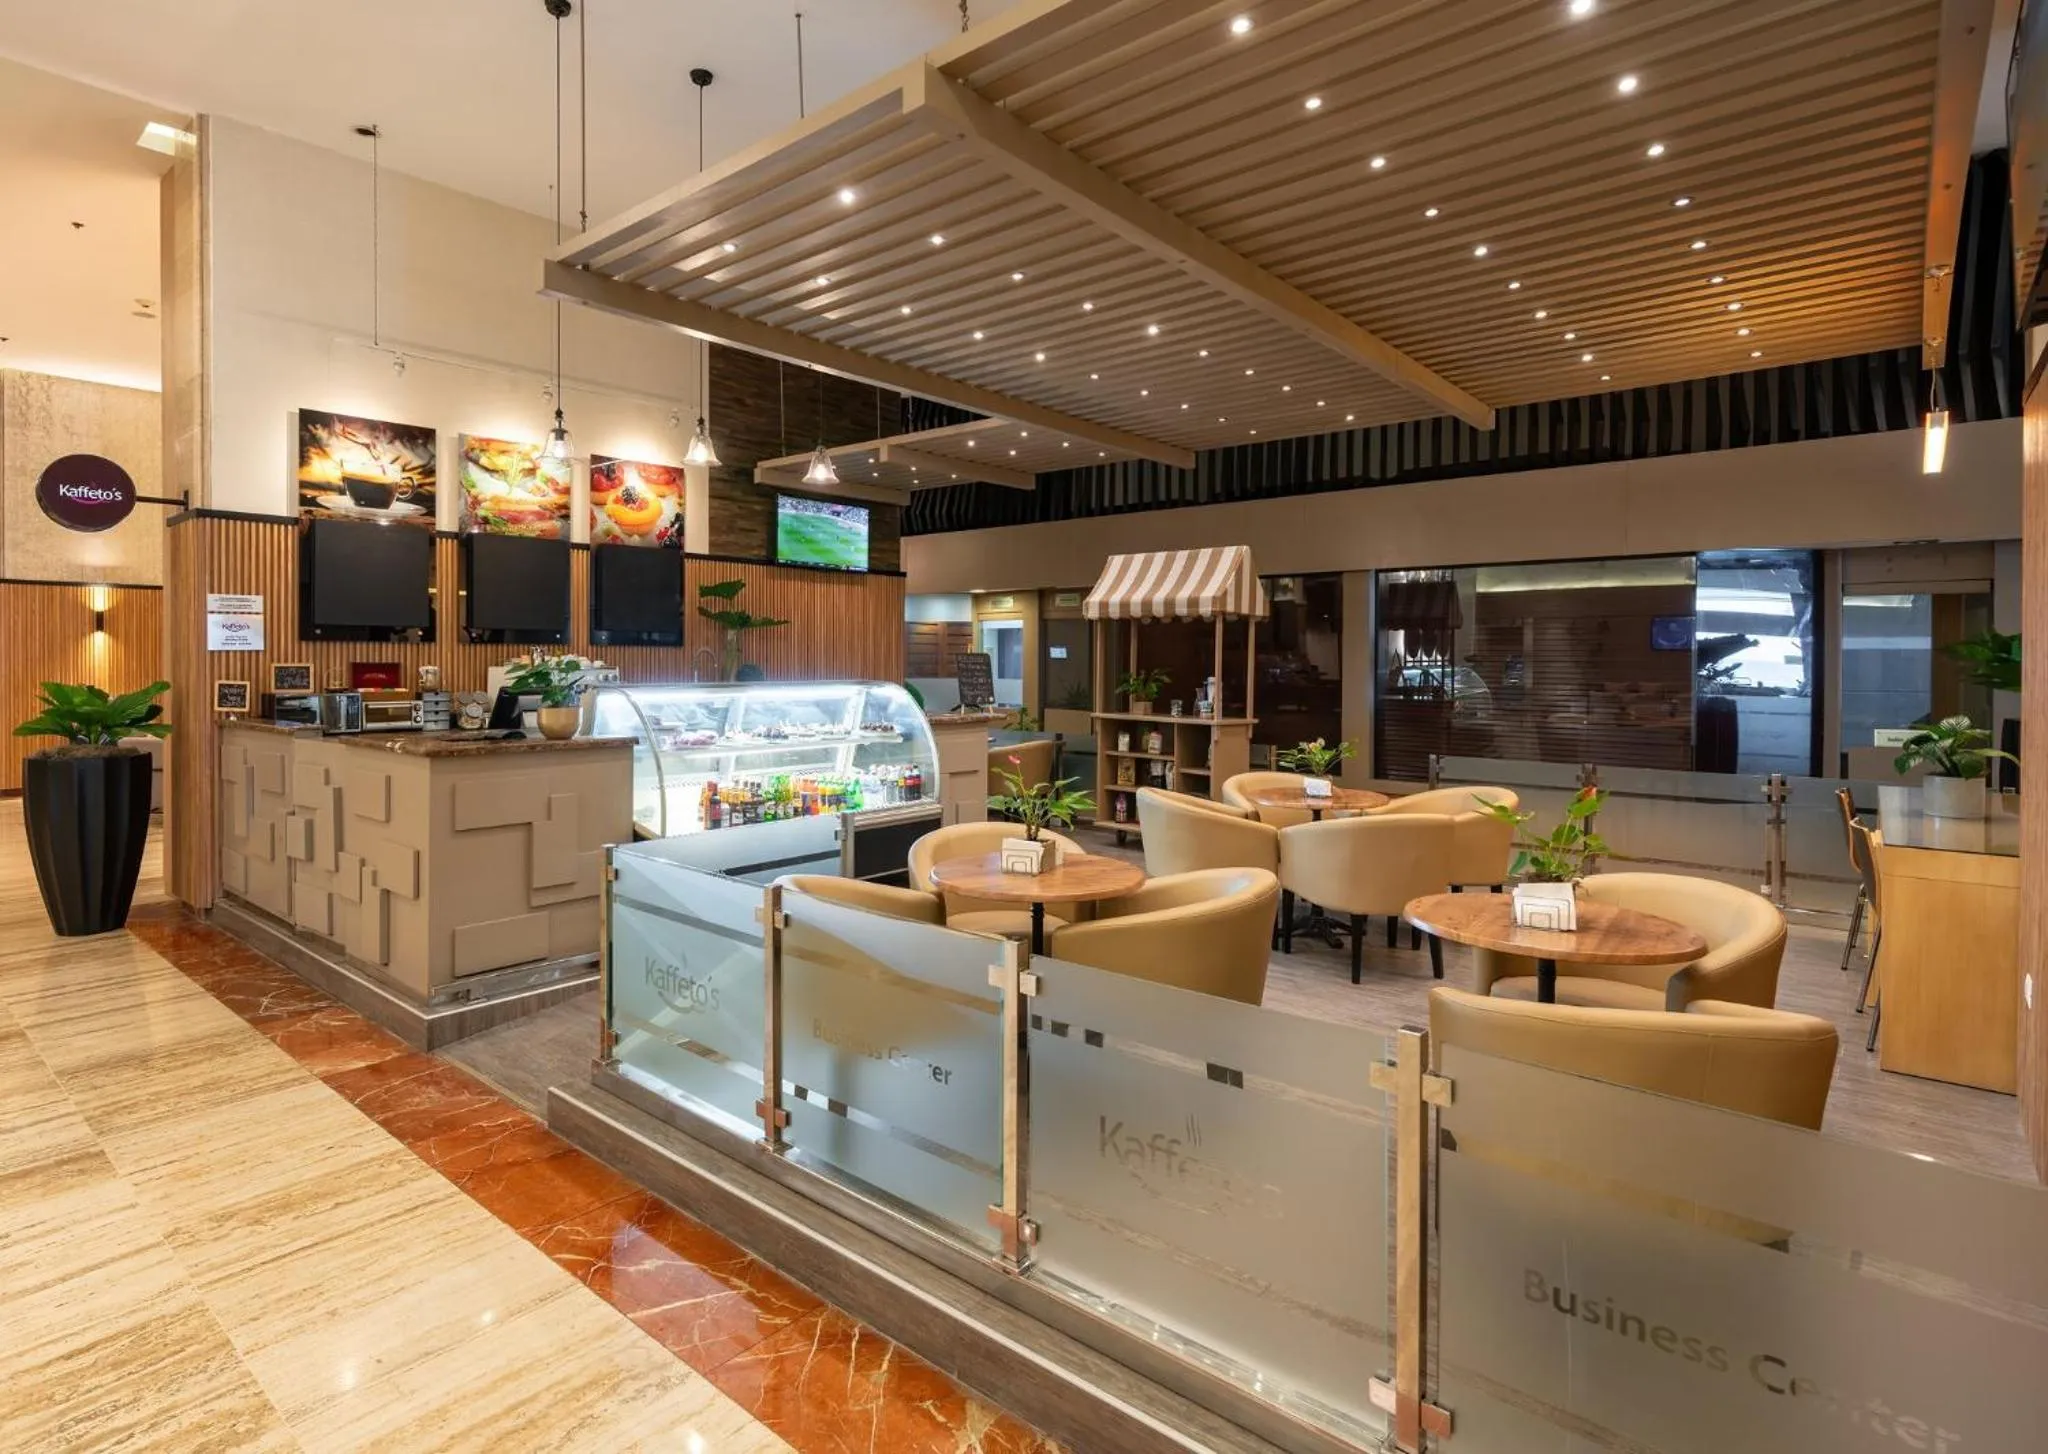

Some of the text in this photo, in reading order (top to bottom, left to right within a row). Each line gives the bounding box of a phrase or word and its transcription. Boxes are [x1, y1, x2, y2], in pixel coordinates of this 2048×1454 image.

[59, 484, 123, 501] Kaffeto's
[645, 956, 720, 1011] Kaffeto's
[1524, 1267, 1963, 1454] Business Ceter
